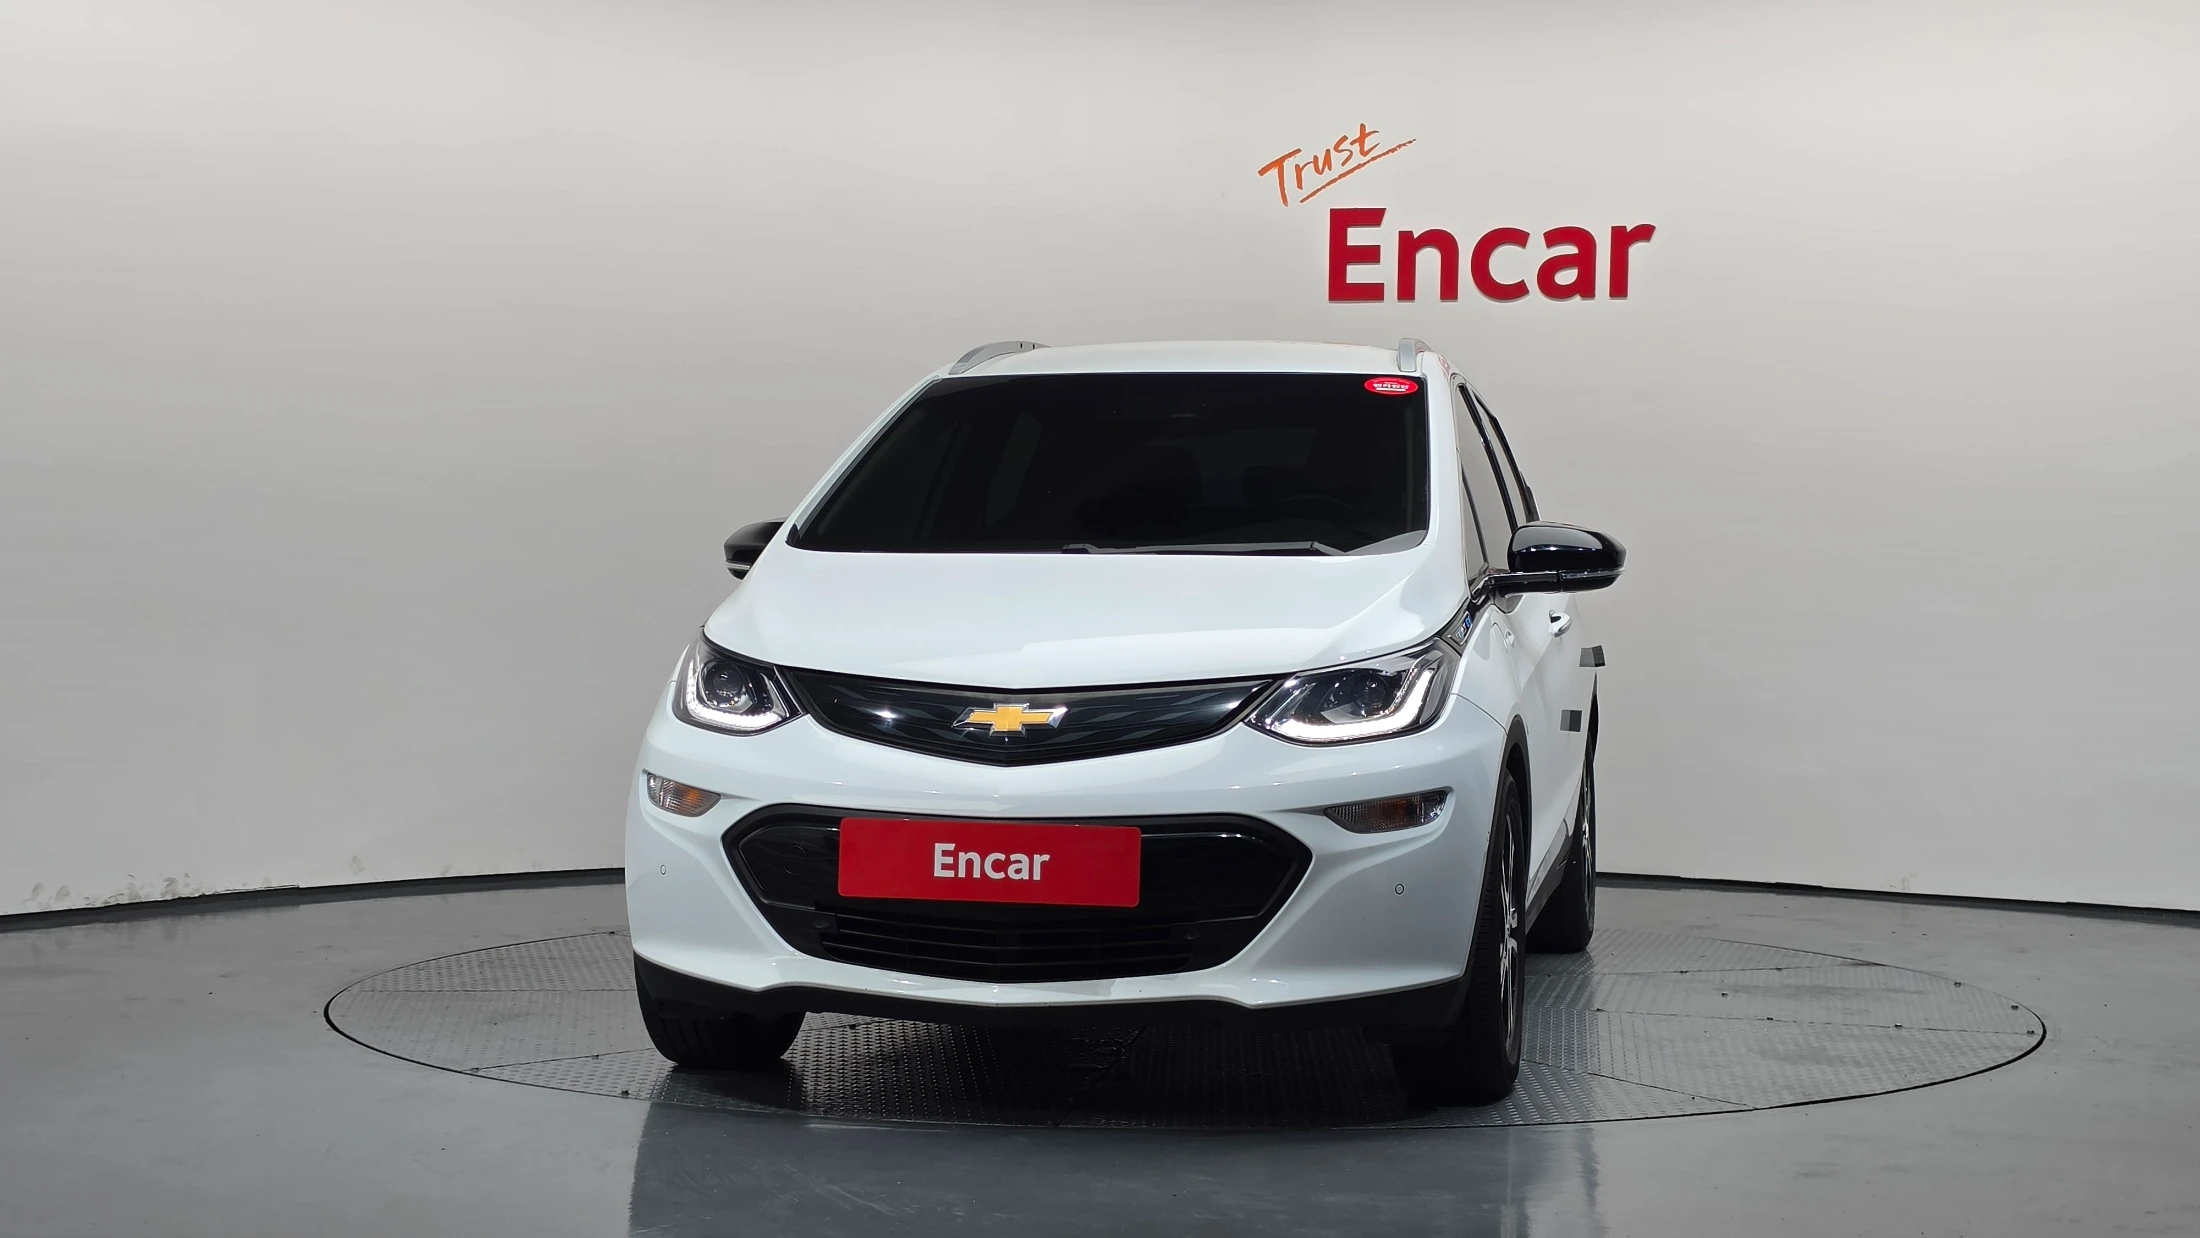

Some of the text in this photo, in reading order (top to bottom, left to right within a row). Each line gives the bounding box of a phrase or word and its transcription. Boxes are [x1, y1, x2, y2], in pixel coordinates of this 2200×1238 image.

[1257, 123, 1381, 208] Trust
[1328, 207, 1656, 302] Encar
[933, 842, 1051, 881] Encar
